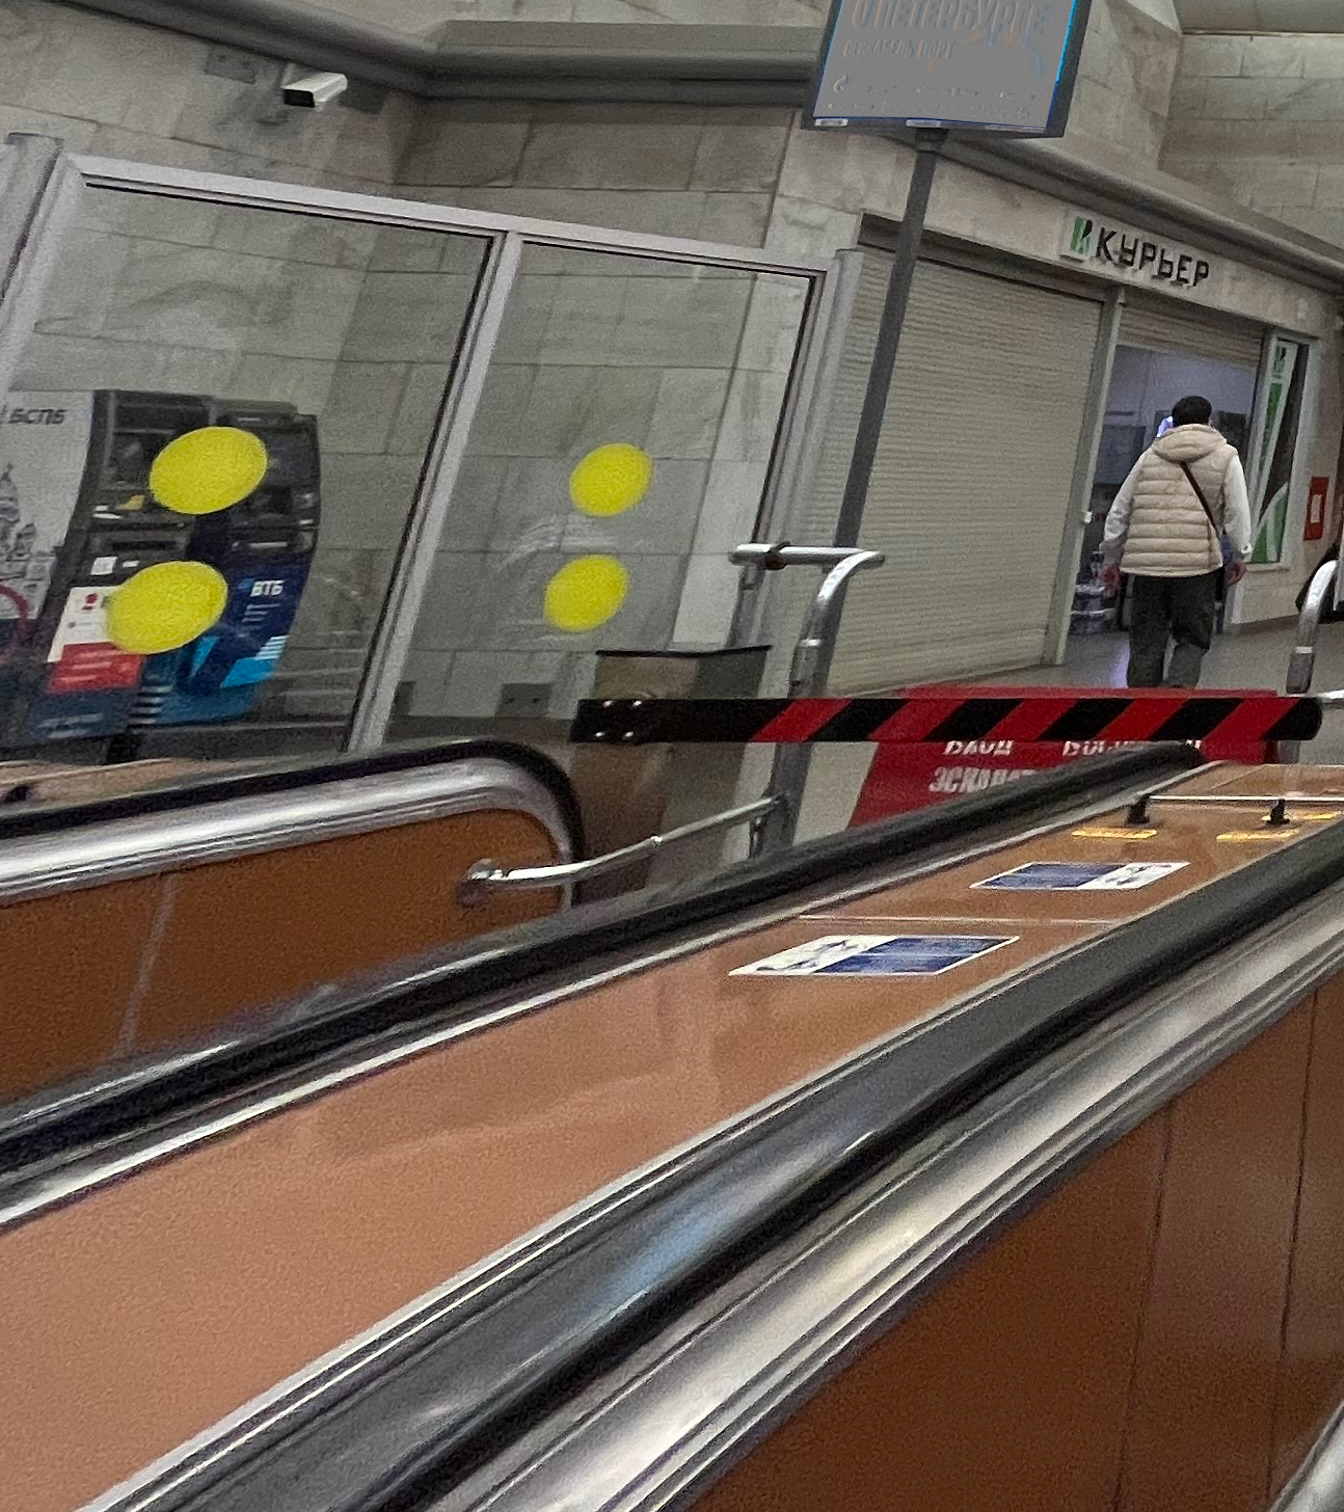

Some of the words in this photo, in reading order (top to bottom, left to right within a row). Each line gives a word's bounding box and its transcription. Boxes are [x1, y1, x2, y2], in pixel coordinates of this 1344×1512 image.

[1095, 226, 1210, 287] КУРЬЕР
[8, 407, 68, 425] БСПБ
[250, 579, 285, 597] ВТБ
